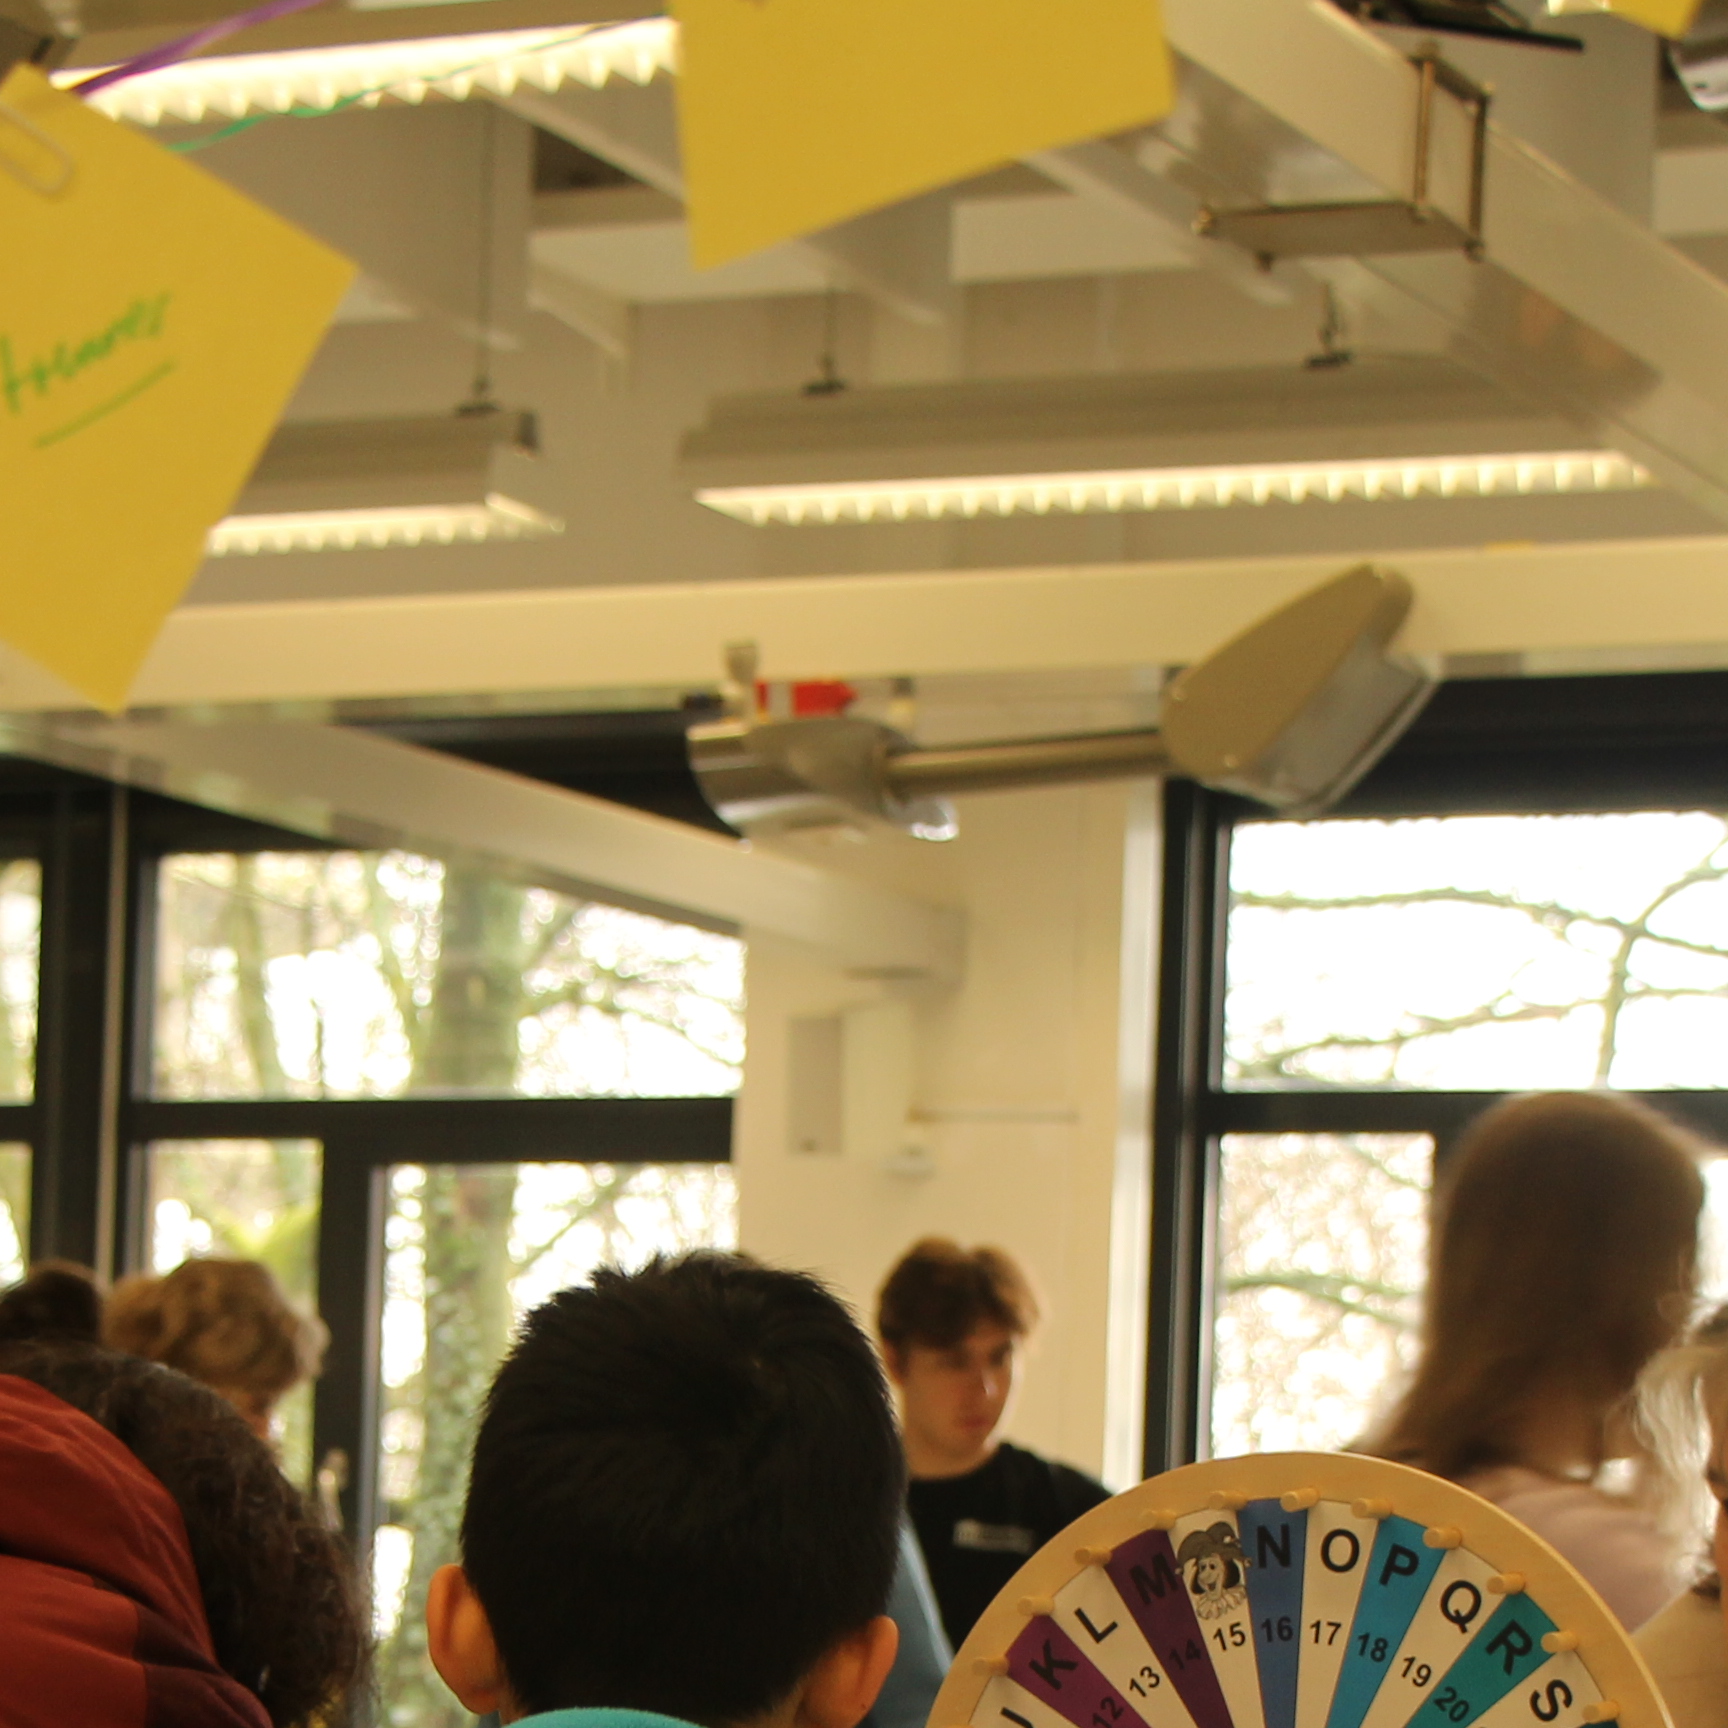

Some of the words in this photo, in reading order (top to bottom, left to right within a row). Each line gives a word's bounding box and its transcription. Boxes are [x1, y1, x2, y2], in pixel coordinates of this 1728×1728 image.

[1257, 1524, 1292, 1568] N
[1321, 1529, 1360, 1573] O
[1129, 1552, 1179, 1606] M
[1379, 1544, 1419, 1589] P
[1440, 1579, 1482, 1634] Q
[1075, 1607, 1119, 1645] L
[1212, 1622, 1246, 1651] 15
[1262, 1616, 1293, 1643] 16
[1310, 1620, 1342, 1646] 17
[1030, 1641, 1079, 1690] K
[1169, 1637, 1202, 1670] 14
[1357, 1632, 1390, 1663] 18
[1485, 1620, 1533, 1674] R
[1128, 1666, 1161, 1700] 13
[1400, 1656, 1434, 1689] 19
[1436, 1685, 1471, 1722] 20
[1530, 1678, 1574, 1722] S
